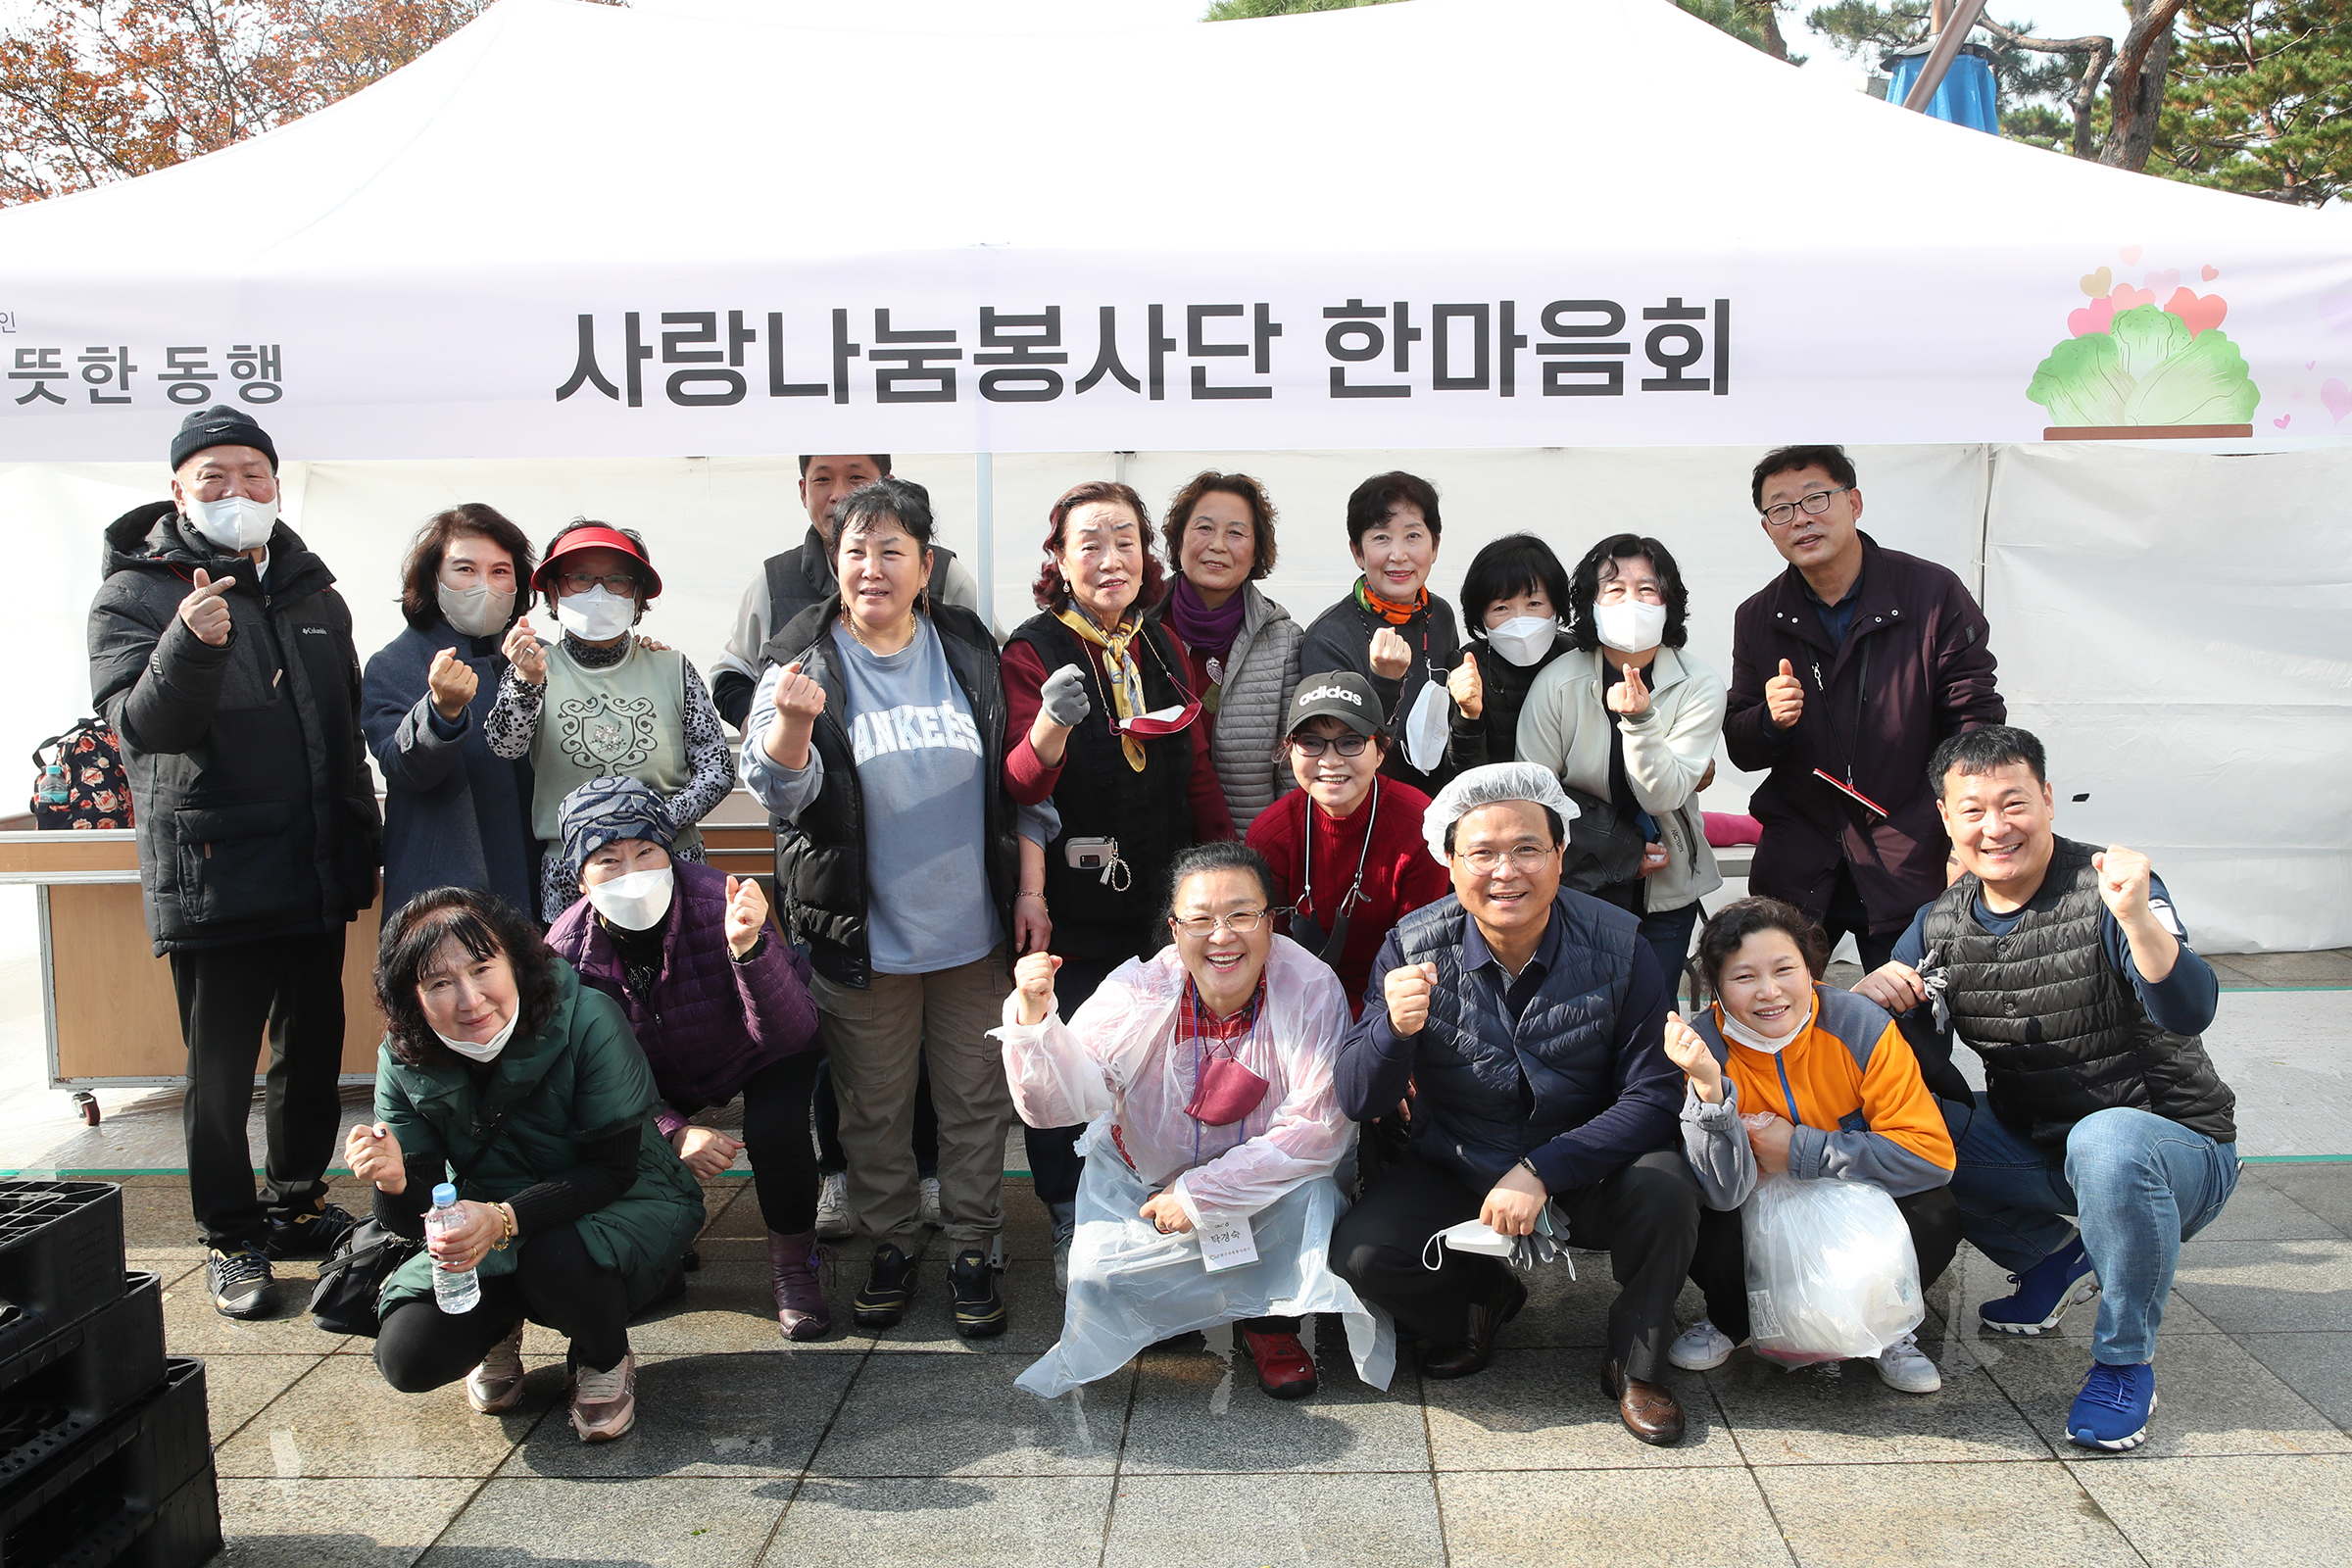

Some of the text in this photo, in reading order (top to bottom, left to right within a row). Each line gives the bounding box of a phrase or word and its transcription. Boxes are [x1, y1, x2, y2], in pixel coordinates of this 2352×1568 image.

[0, 311, 17, 334] 인
[556, 297, 1731, 408] 사랑나눔봉사단 한마음회
[157, 344, 283, 405] 동행
[1298, 685, 1362, 707] adidas
[847, 704, 984, 767] ANKEES
